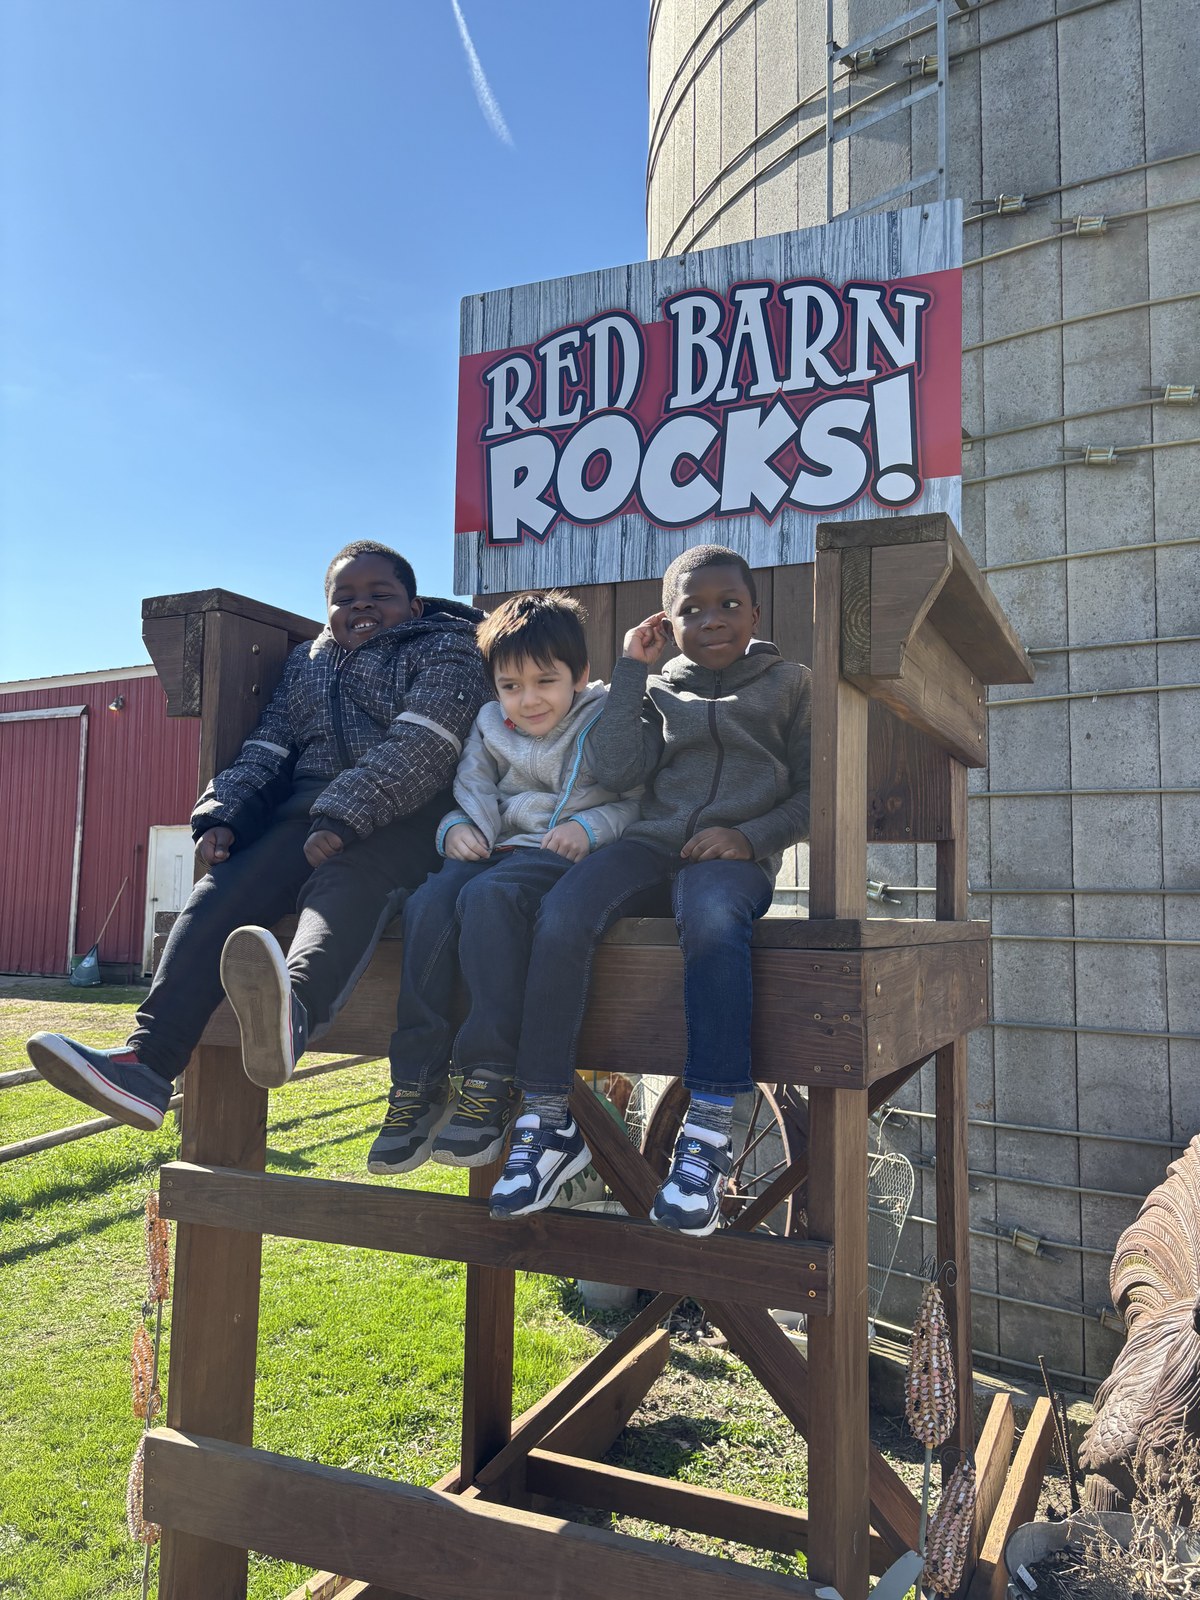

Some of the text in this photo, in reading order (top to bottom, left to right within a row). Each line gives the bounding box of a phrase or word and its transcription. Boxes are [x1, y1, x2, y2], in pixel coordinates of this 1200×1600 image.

[483, 283, 926, 438] RED BARN
[488, 371, 917, 541] ROCKS!
